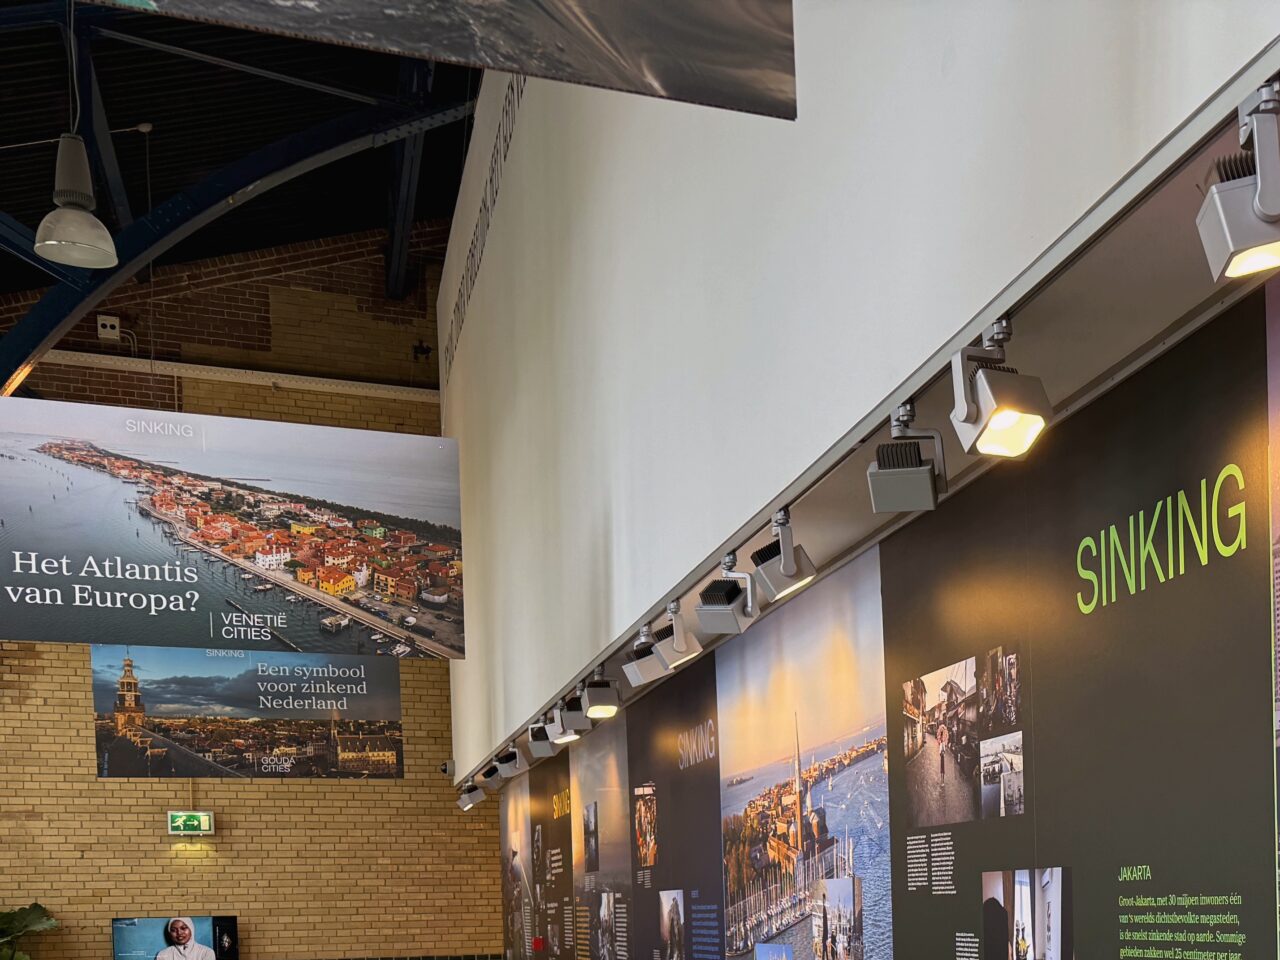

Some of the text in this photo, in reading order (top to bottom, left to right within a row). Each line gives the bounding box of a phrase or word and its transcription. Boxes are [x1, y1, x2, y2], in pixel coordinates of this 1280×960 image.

[125, 419, 194, 438] SINKING
[1076, 463, 1248, 615] SINKING
[12, 550, 199, 583] Het Atlantis
[4, 584, 200, 616] van Europa?
[221, 612, 288, 628] VENETIË
[221, 626, 272, 640] CITIES
[206, 650, 245, 658] SINKING
[257, 662, 366, 679] Een symbool
[257, 680, 368, 694] voor zinkend
[258, 695, 348, 710] Nederland
[678, 719, 716, 770] SINKING
[261, 756, 296, 765] GOUDA
[261, 764, 291, 773] CITIES
[1118, 865, 1152, 882] JAKARTA
[1118, 892, 1242, 908] Groot-Jakarta, met 30 miljoen inwoners één
[1200, 912, 1240, 926] megasteden,
[1182, 948, 1216, 960] centimeter
